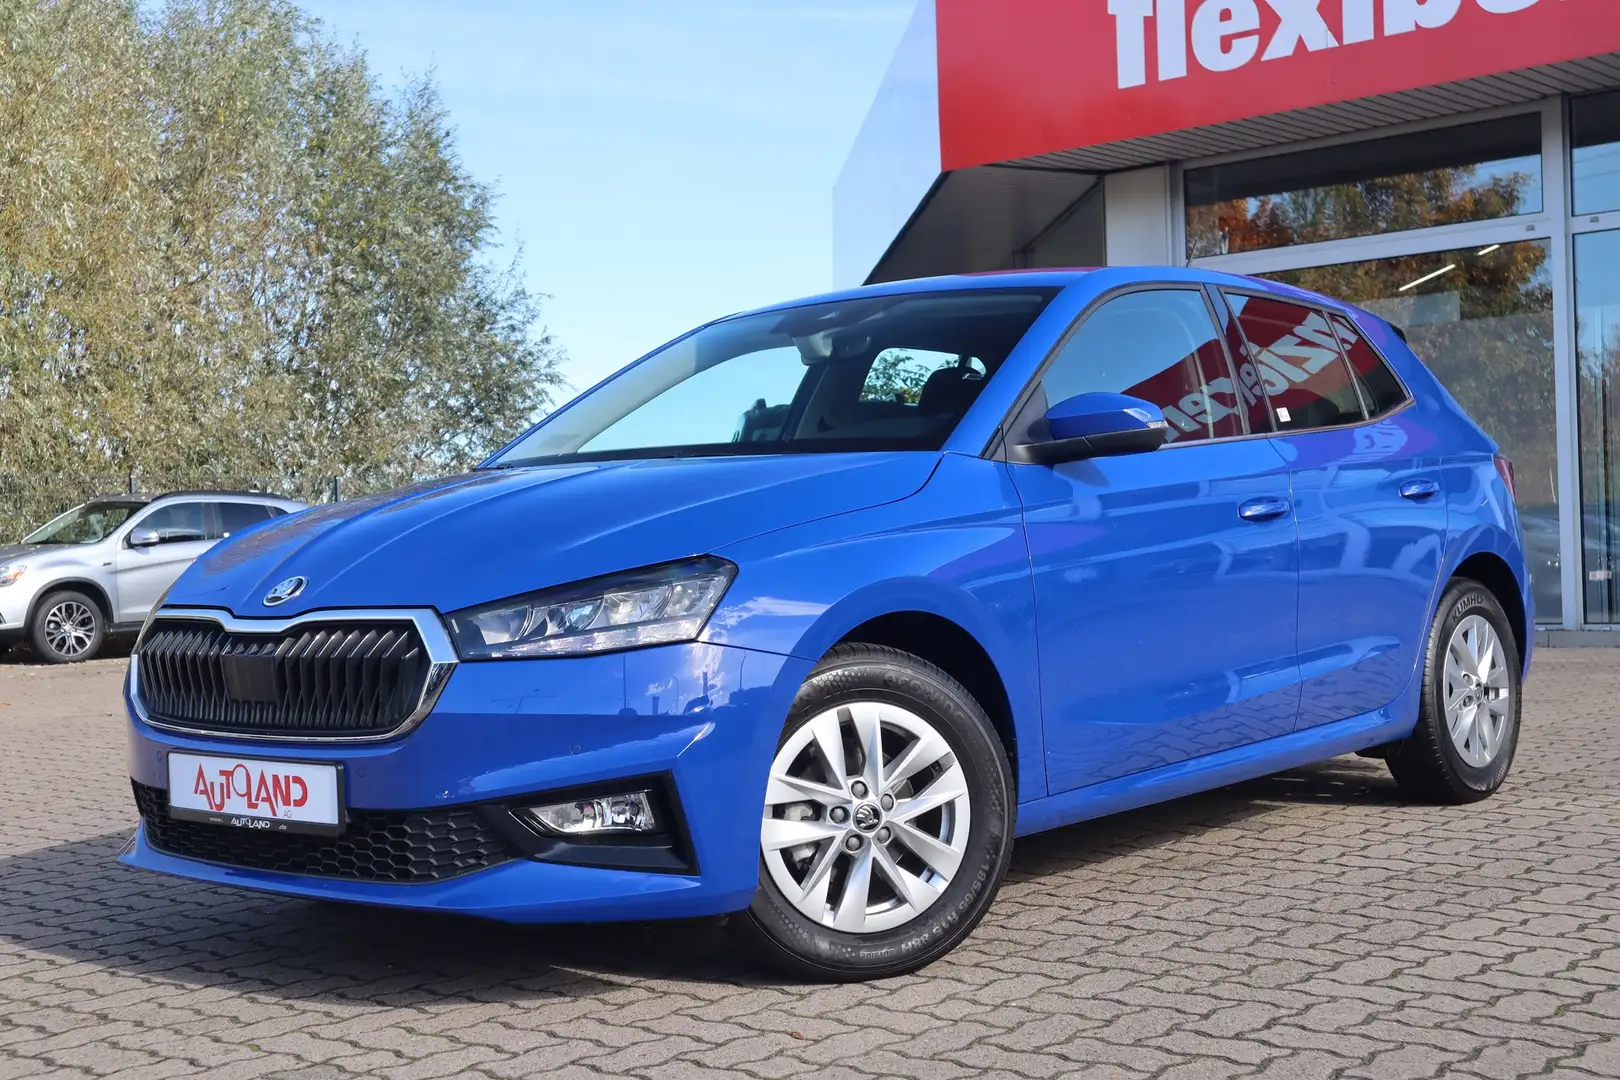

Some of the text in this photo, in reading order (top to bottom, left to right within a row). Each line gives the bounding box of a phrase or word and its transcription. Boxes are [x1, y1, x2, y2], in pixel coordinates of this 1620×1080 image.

[1108, 0, 1541, 89] flex
[1451, 593, 1485, 624] KUMHO
[194, 762, 308, 817] AUTOLAND
[230, 816, 270, 830] AUTOLAND
[283, 809, 293, 819] AG
[958, 862, 990, 912] 185/65
[932, 909, 960, 935] R15
[901, 933, 930, 954] 88H
